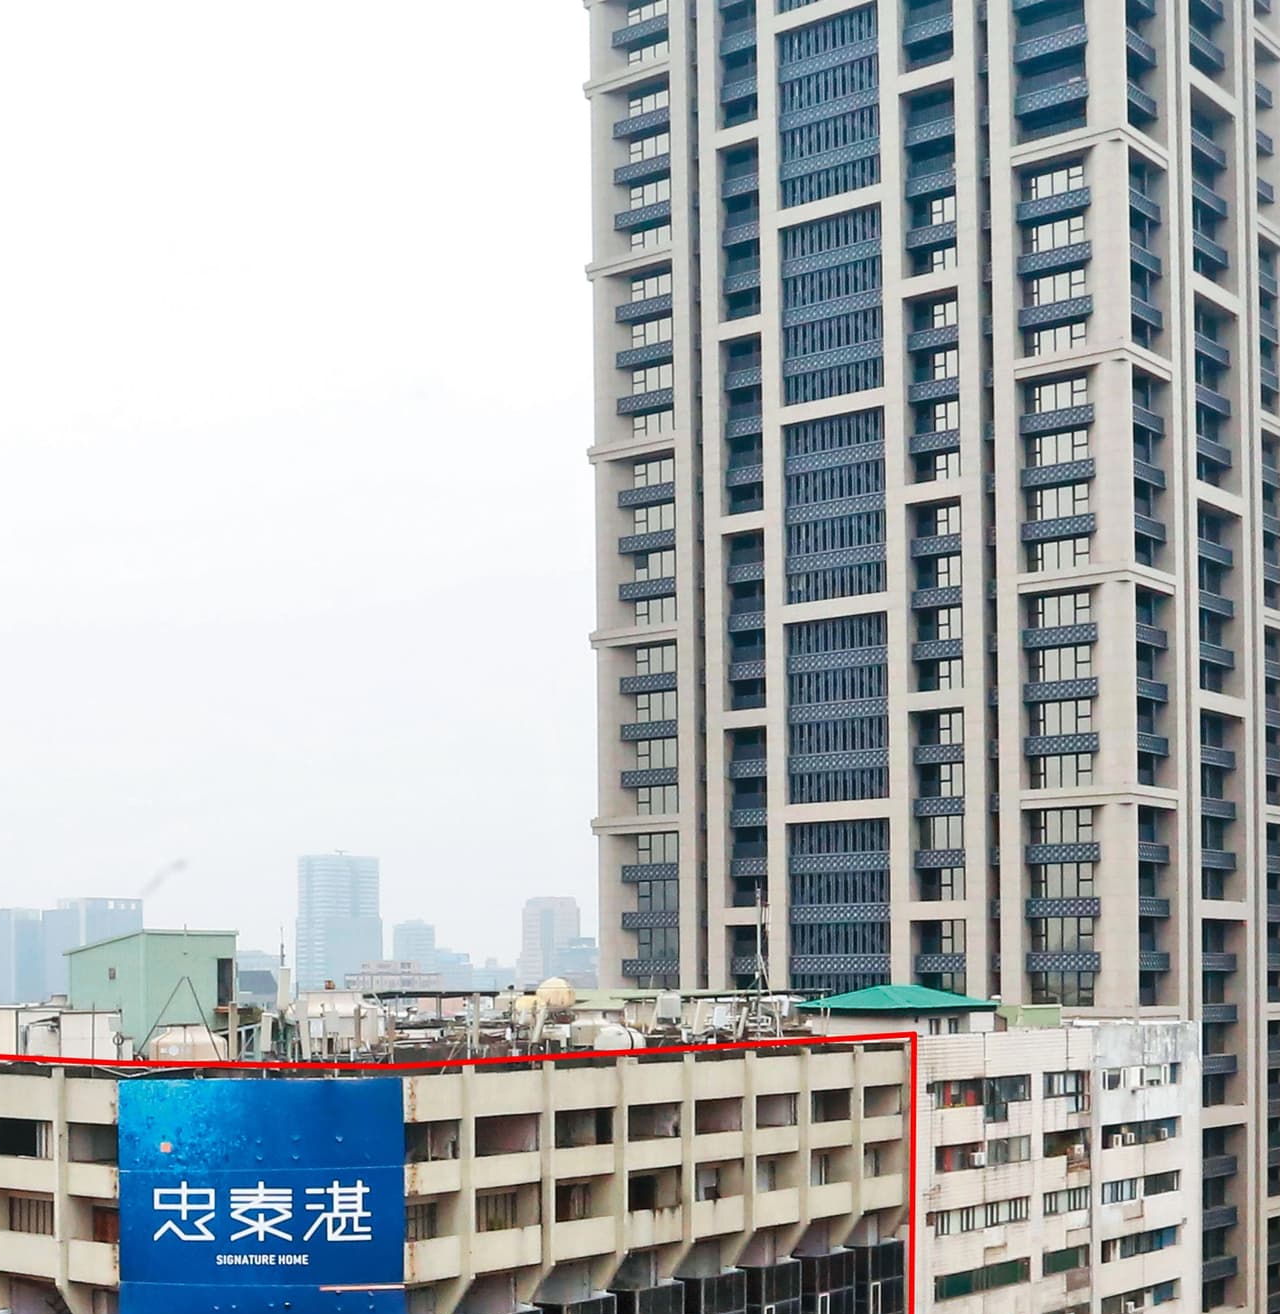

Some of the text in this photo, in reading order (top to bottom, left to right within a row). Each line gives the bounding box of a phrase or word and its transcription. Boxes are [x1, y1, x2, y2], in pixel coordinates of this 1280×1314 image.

[153, 1179, 373, 1242] 忠泰湛
[216, 1254, 309, 1266] SIGNATURE HOME
